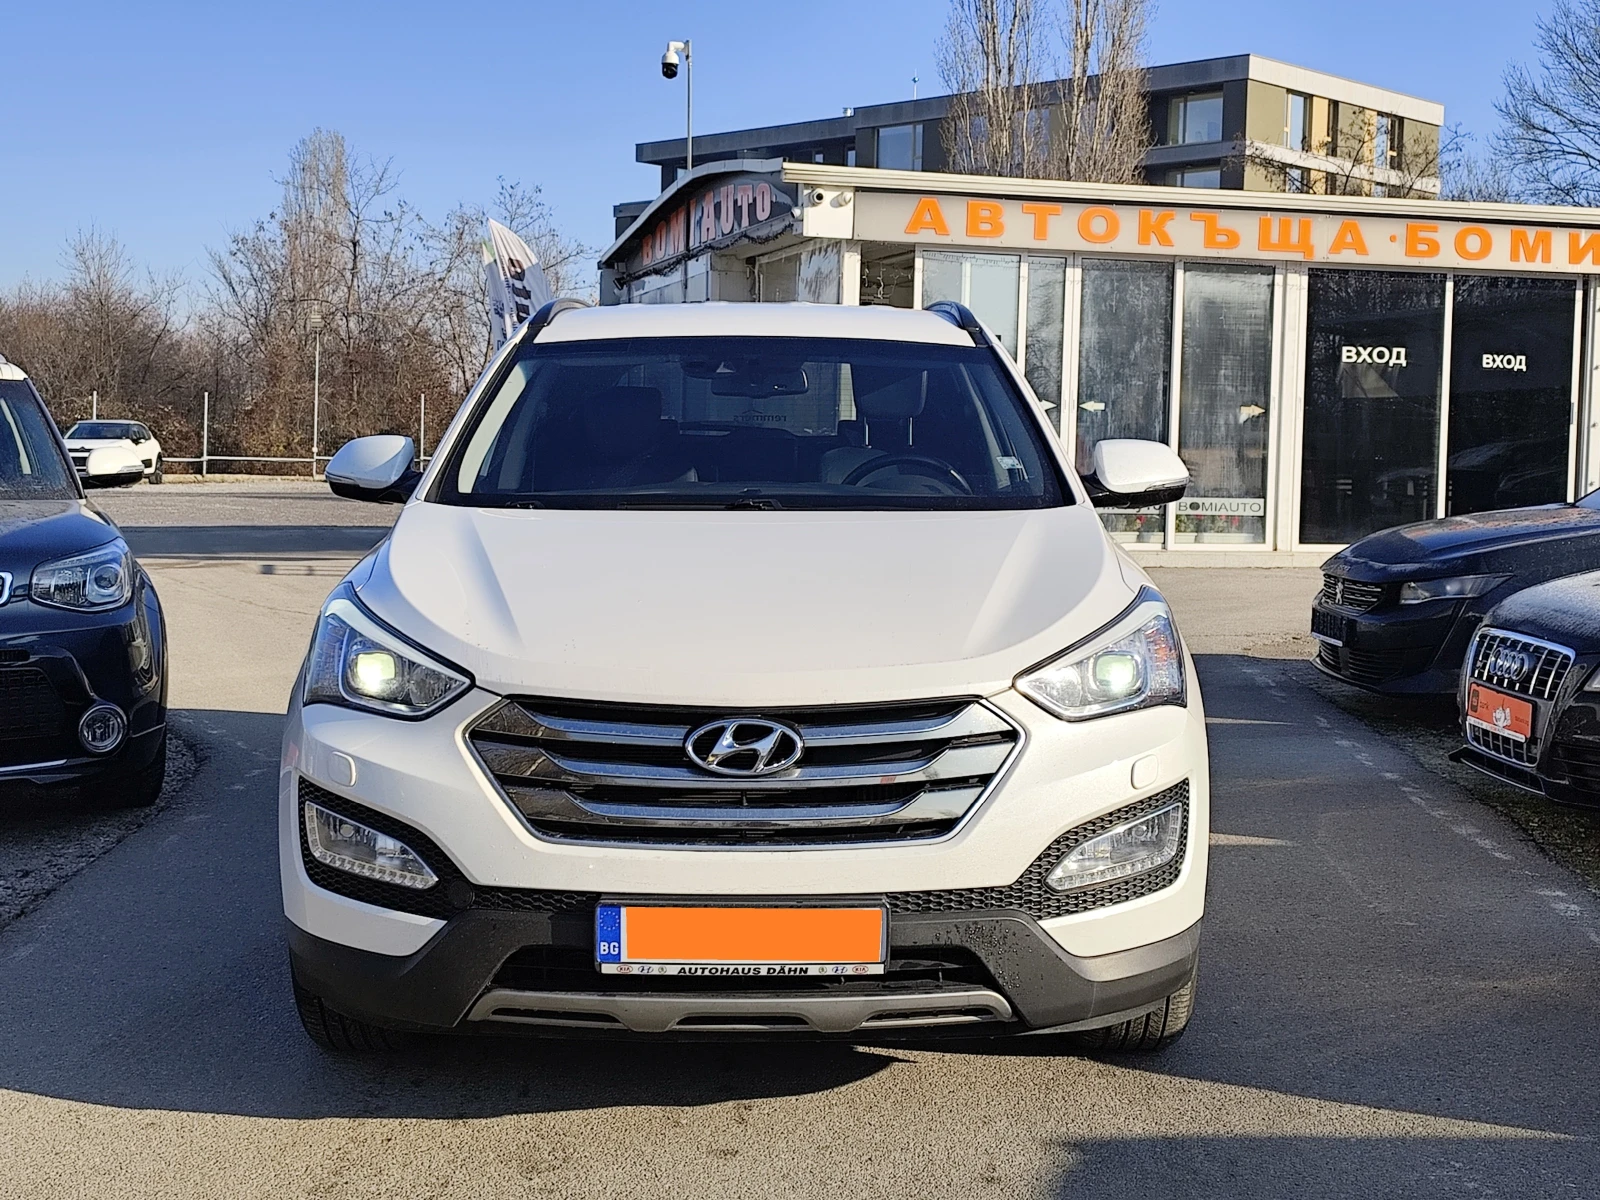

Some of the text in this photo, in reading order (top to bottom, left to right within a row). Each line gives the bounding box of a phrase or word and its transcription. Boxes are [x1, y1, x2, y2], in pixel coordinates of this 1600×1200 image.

[1341, 345, 1408, 367] ВХОД
[1482, 353, 1527, 372] ВХОД
[600, 941, 620, 956] BG
[677, 966, 761, 976] AUTOHAUS
[766, 965, 809, 976] DÄHN
